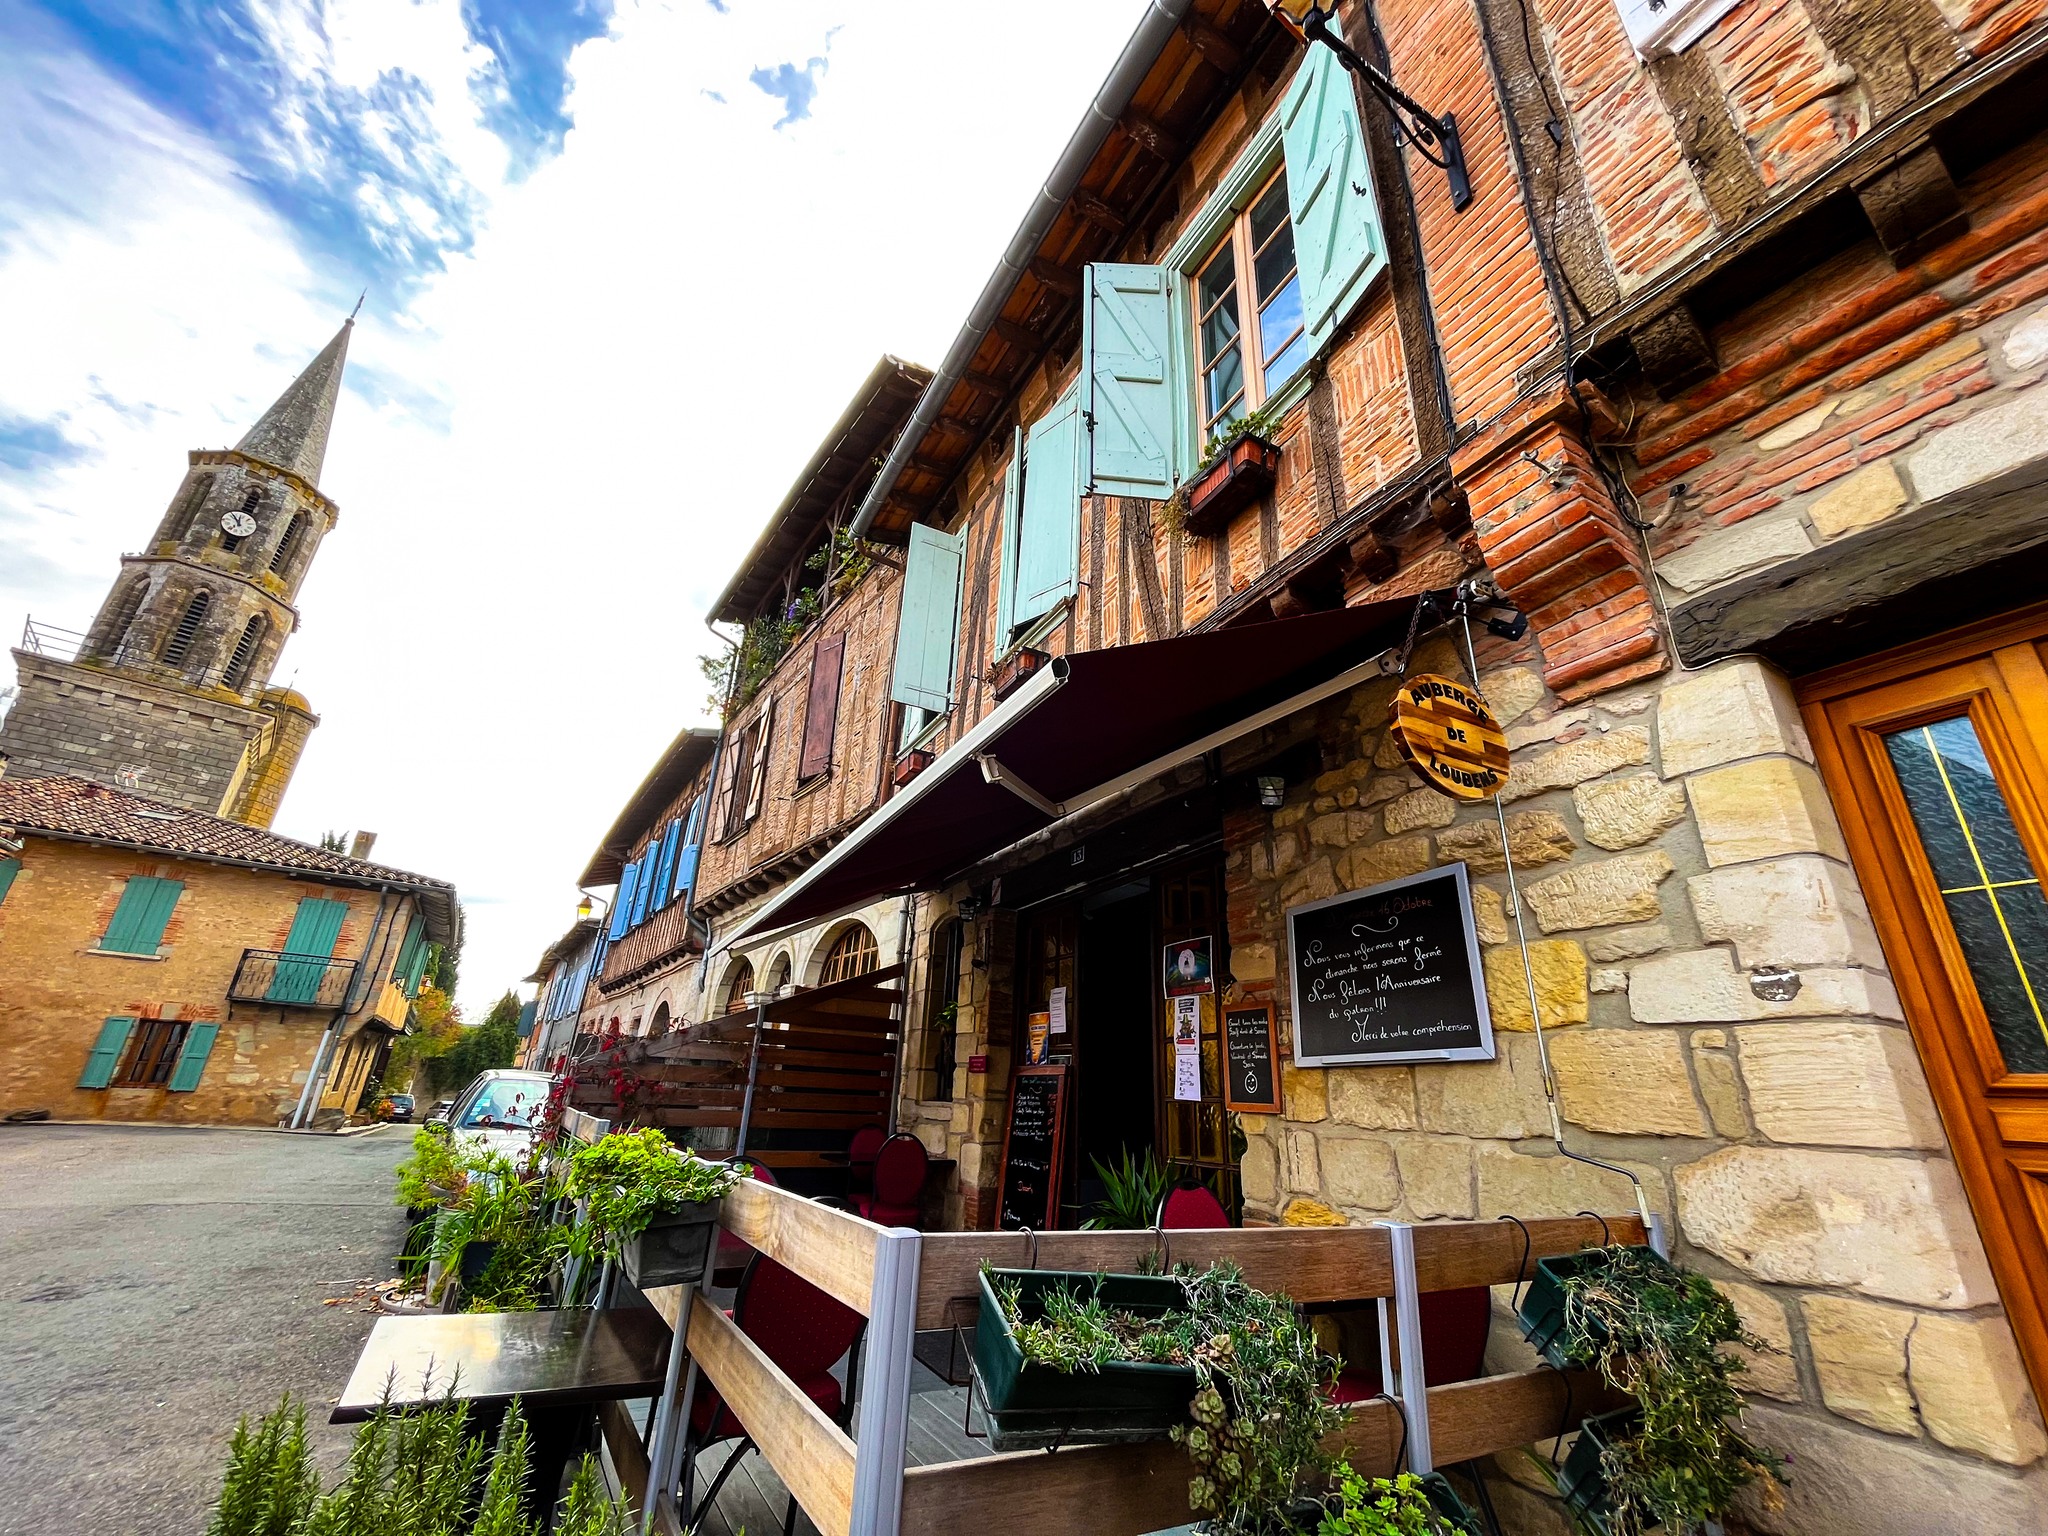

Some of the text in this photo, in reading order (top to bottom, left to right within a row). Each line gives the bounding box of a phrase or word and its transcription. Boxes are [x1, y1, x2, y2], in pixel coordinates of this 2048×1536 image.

[1410, 682, 1489, 724] AUBERGE
[1446, 726, 1467, 743] DE
[1430, 754, 1498, 788] LOUBENS
[1073, 850, 1082, 862] 13
[1304, 939, 1331, 967] Nous
[1334, 952, 1351, 960] vous
[1354, 942, 1394, 961] informons
[1398, 938, 1411, 951] que
[1325, 946, 1442, 979] dimanche nous serons fermé
[1307, 978, 1336, 1002] Nous
[1329, 1008, 1339, 1019] du
[1351, 1014, 1472, 1043] Merci de votre compréhension
